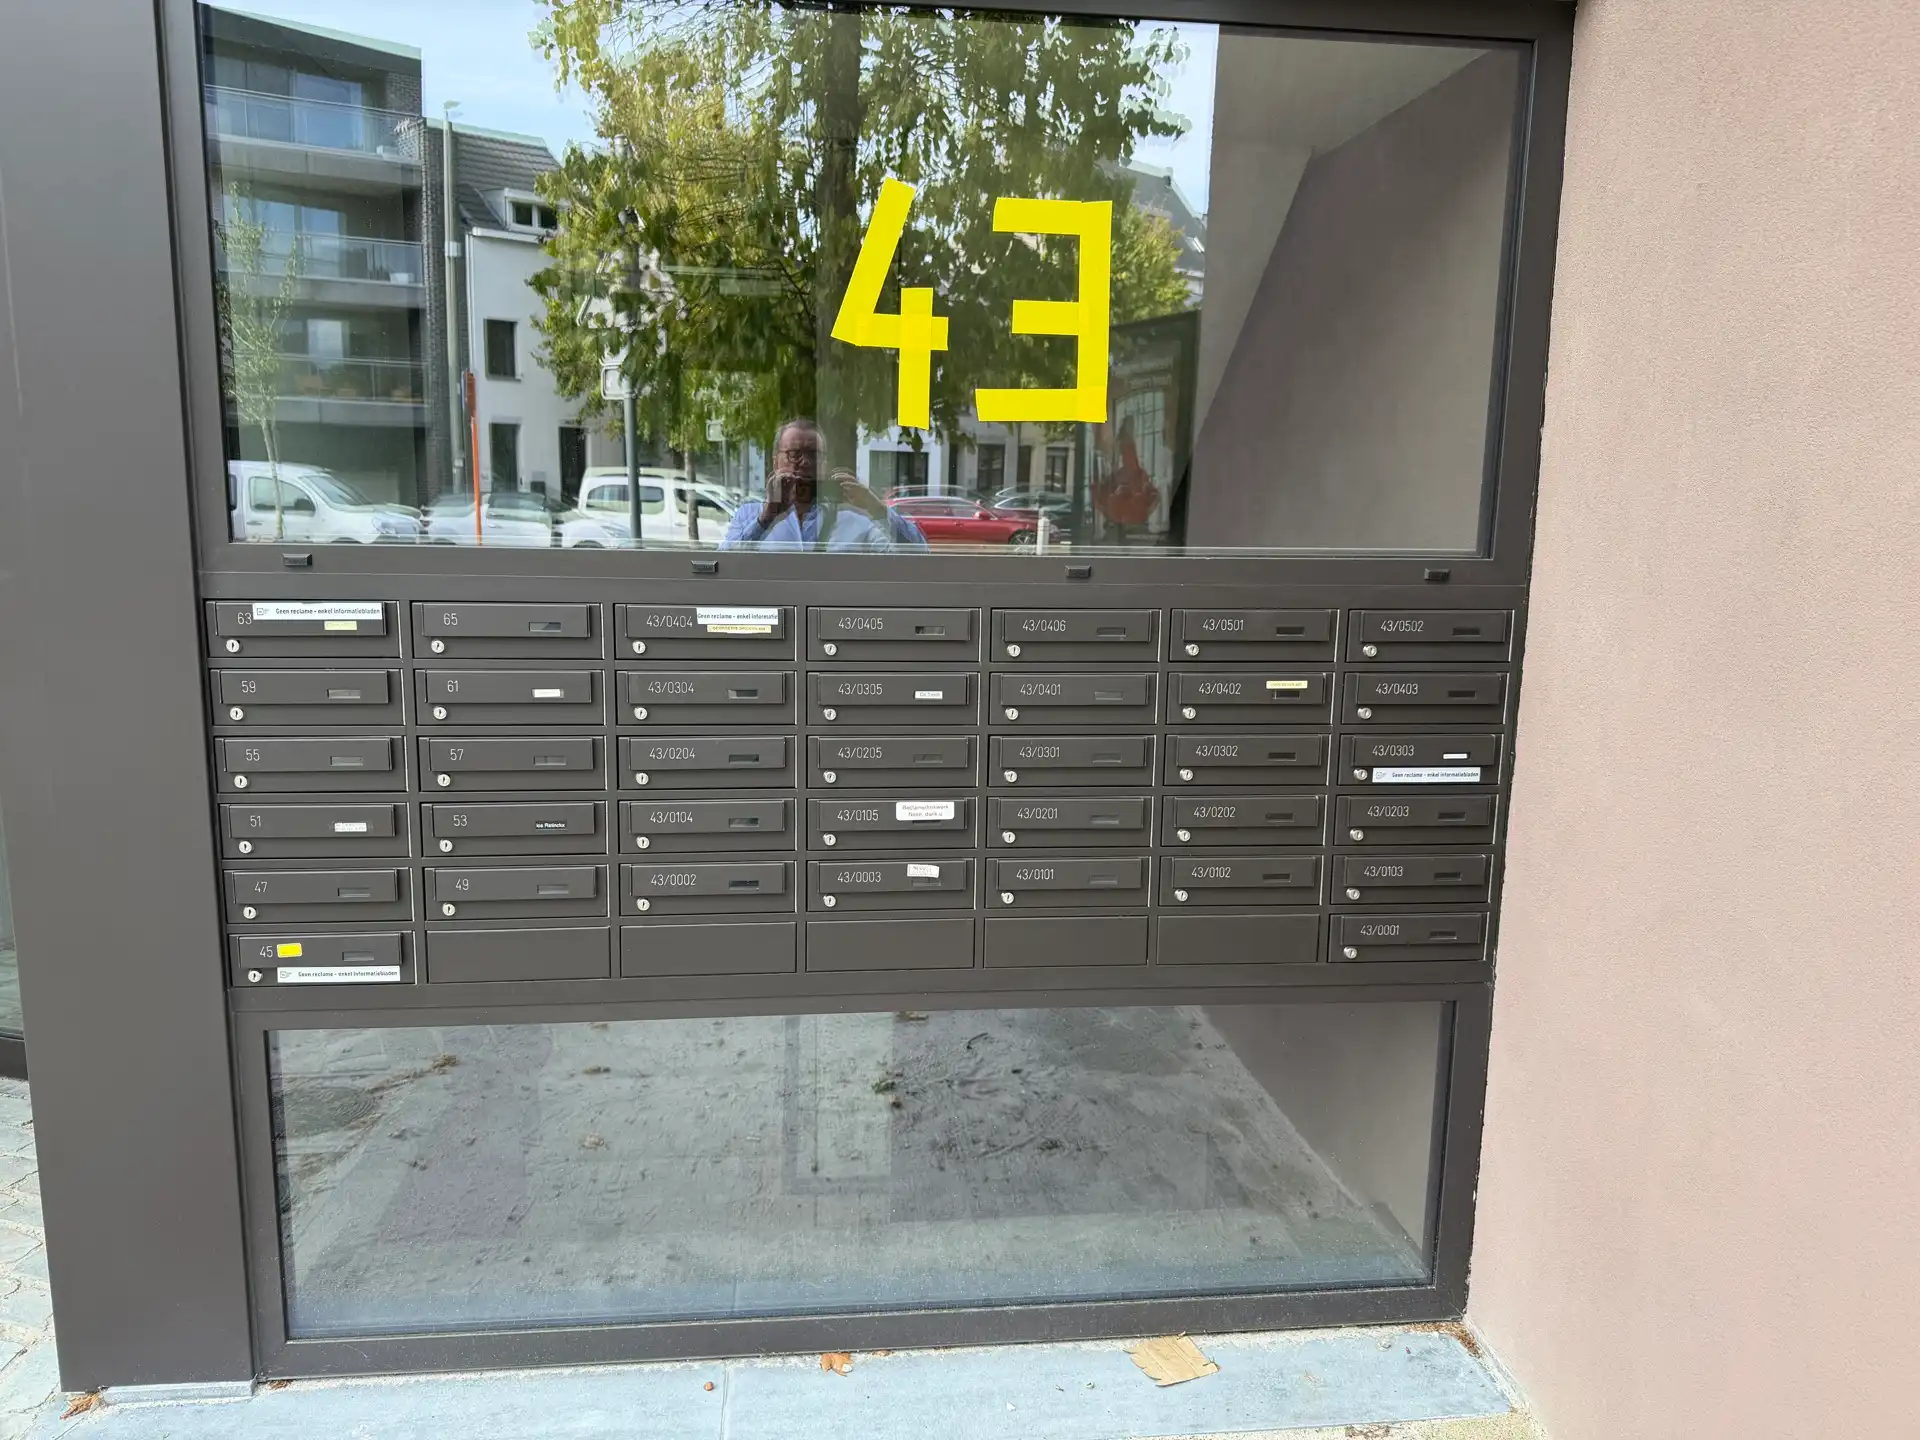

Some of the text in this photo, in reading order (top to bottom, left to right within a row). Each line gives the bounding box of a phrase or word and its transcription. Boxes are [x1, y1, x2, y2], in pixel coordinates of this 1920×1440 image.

[831, 176, 1113, 429] 43
[237, 611, 252, 625] 63
[443, 612, 458, 626] 65
[646, 614, 693, 628] 43/0404
[838, 616, 884, 630] 43/0405
[1202, 618, 1244, 631] 43/0501
[1022, 619, 1067, 632] 43/0406
[1380, 619, 1424, 632] 43/0502
[241, 680, 257, 694] 59
[447, 679, 459, 693] 61
[647, 681, 694, 694] 43/0304
[837, 683, 883, 696] 43/0305
[1019, 683, 1061, 696] 43/0401
[1198, 682, 1242, 695] 43/0402
[1375, 682, 1419, 695] 43/0403
[245, 748, 260, 762] 55
[450, 748, 464, 761] 57
[649, 747, 696, 760] 43/0204
[837, 746, 883, 759] 43/0205
[1019, 746, 1060, 758] 43/0301
[1195, 744, 1239, 757] 43/0302
[1371, 744, 1415, 757] 43/0303
[649, 811, 694, 824] 43/0104
[837, 809, 879, 822] 43/0105
[1017, 807, 1058, 820] 43/0201
[1193, 806, 1236, 818] 43/0202
[1367, 805, 1410, 817] 43/0203
[249, 815, 262, 828] 51
[453, 814, 468, 827] 53
[837, 871, 882, 884] 43/0003
[1016, 868, 1054, 881] 43/0101
[1191, 866, 1232, 879] 43/0102
[1363, 865, 1404, 877] 43/0103
[455, 878, 469, 891] 49
[650, 873, 697, 886] 43/0002
[254, 881, 268, 893] 47
[1360, 924, 1400, 936] 43/0001
[259, 945, 274, 958] 45
